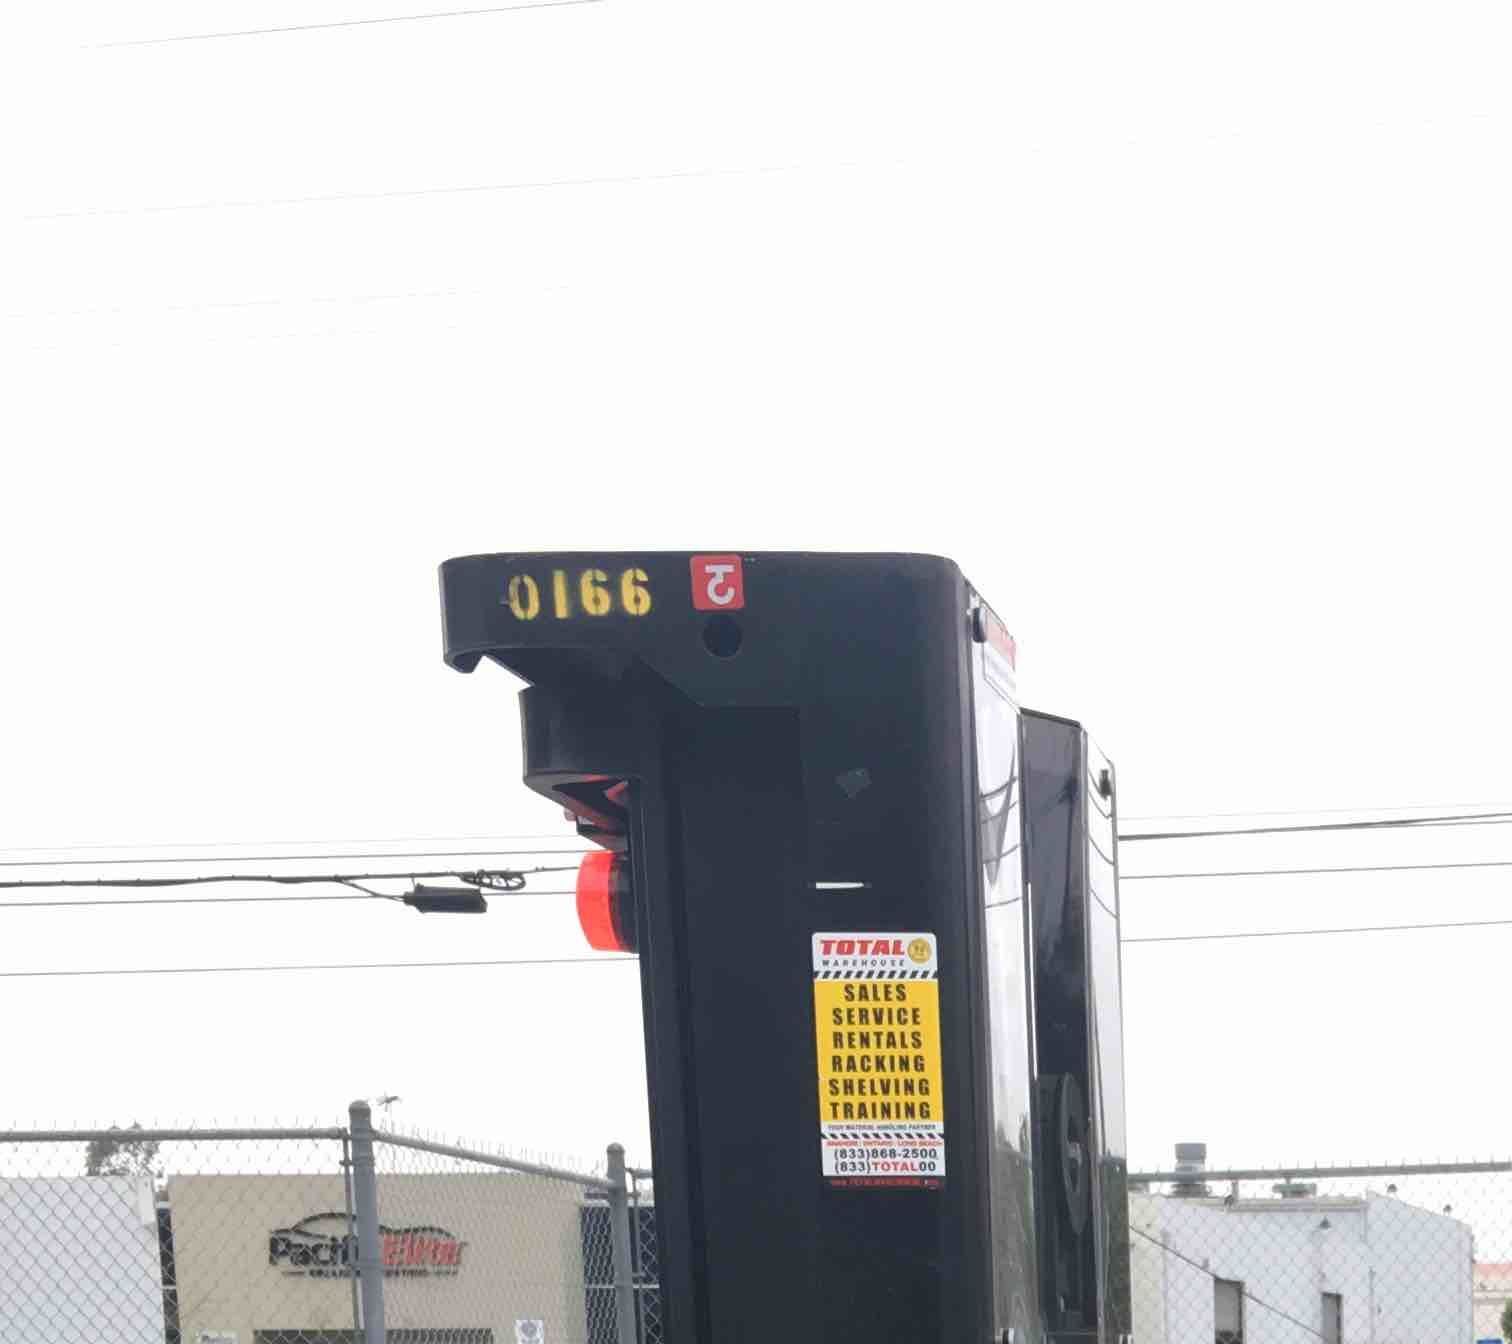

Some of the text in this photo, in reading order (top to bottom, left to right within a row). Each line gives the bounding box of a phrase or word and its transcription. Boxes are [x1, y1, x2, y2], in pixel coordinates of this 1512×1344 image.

[508, 568, 651, 620] 0166
[820, 940, 905, 956] TOTAL
[822, 959, 905, 967] WAREHOUSE
[844, 984, 907, 1001] SALES
[832, 1008, 921, 1025] SERVICE
[832, 1031, 922, 1049] RENTALS
[831, 1055, 926, 1072] RACKING
[829, 1079, 930, 1096] SHELVING
[830, 1102, 931, 1119] TRAINING
[835, 1161, 936, 1175] (833)TOTAL00
